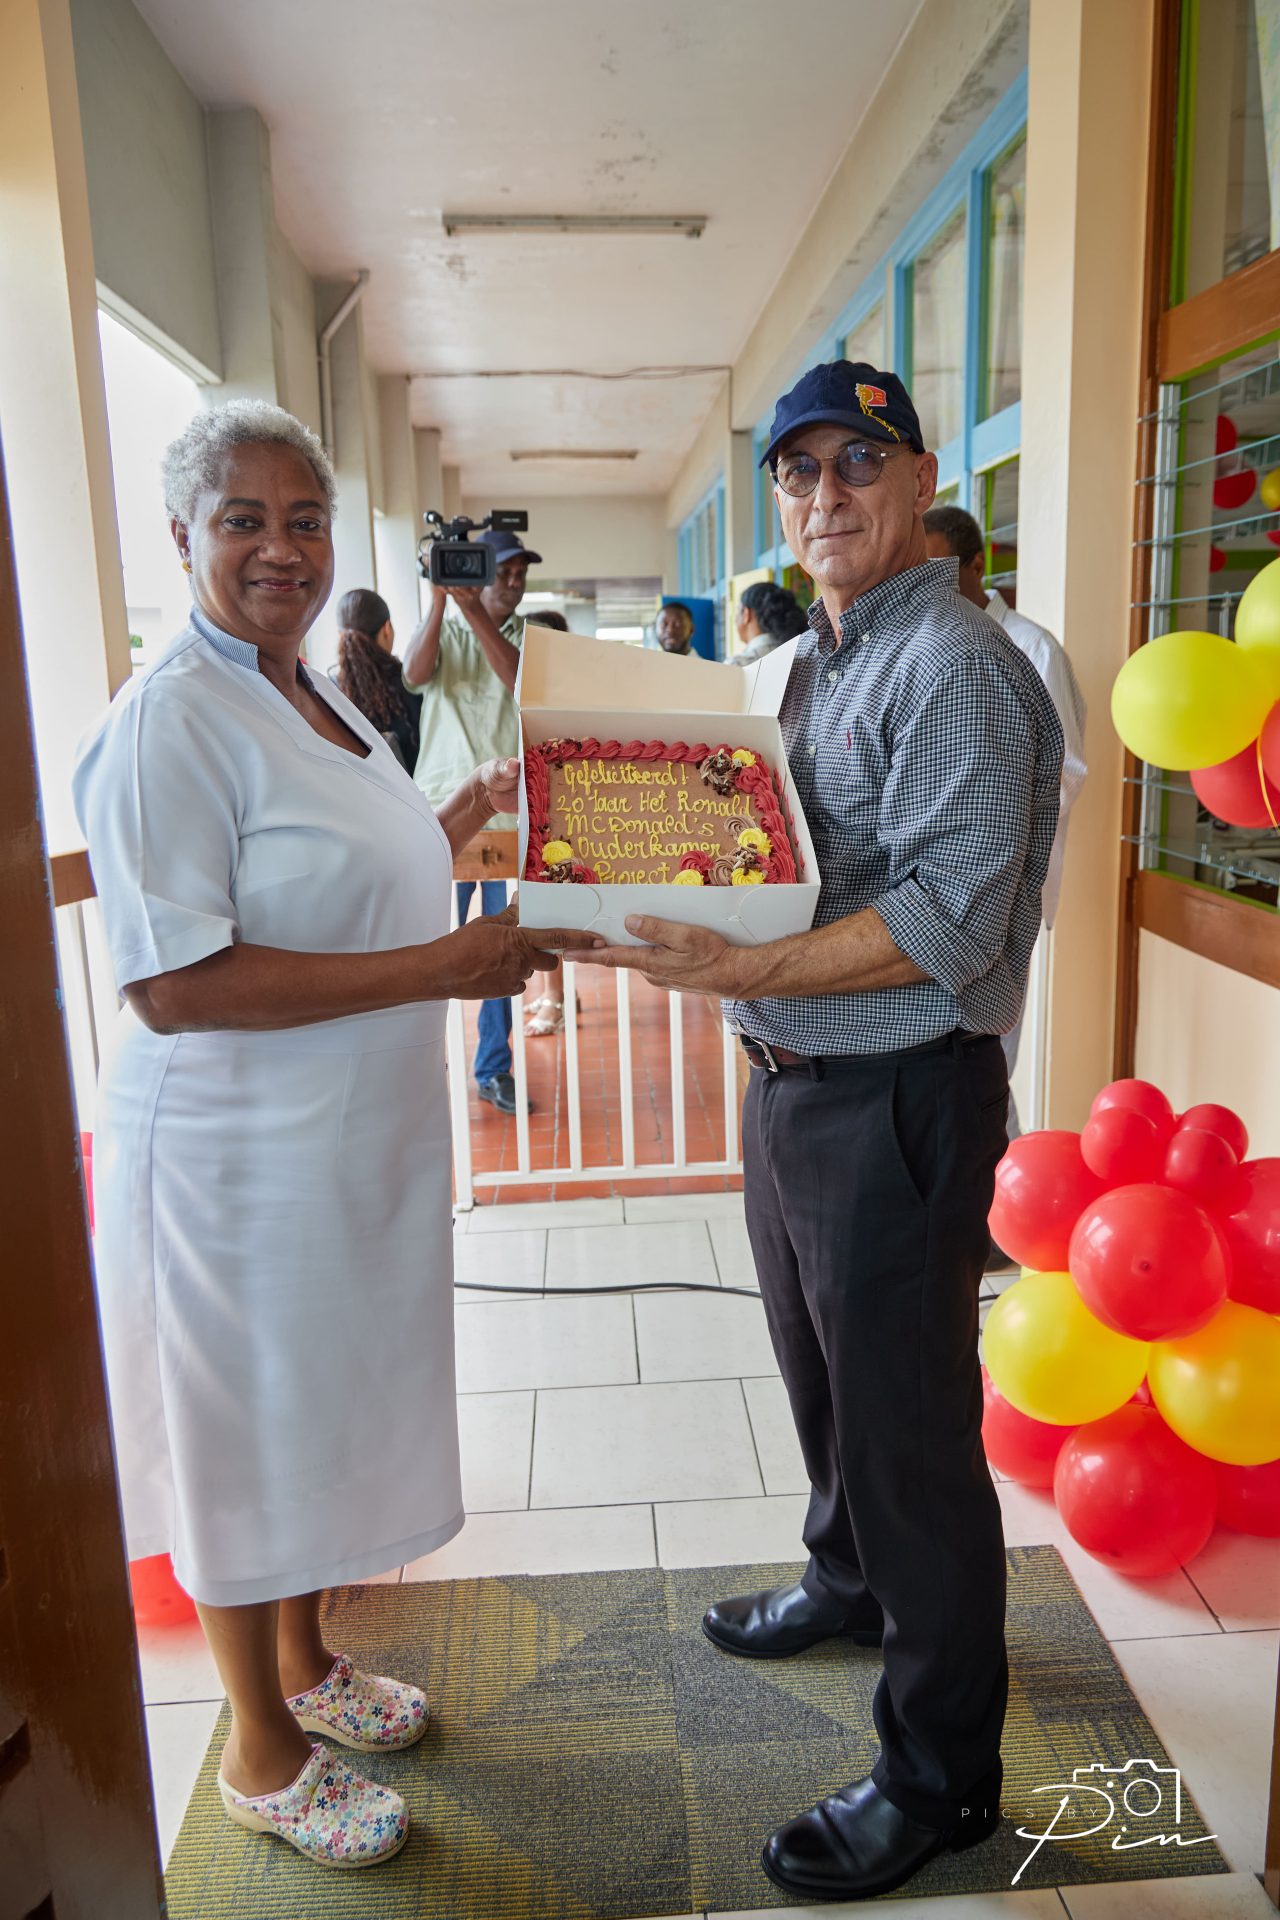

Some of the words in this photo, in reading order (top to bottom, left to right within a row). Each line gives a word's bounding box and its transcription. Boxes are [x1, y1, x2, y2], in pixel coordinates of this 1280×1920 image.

[556, 795, 584, 813] 20
[639, 789, 669, 813] Het
[677, 790, 756, 818] Ronald
[577, 834, 726, 859] Ouderkamer
